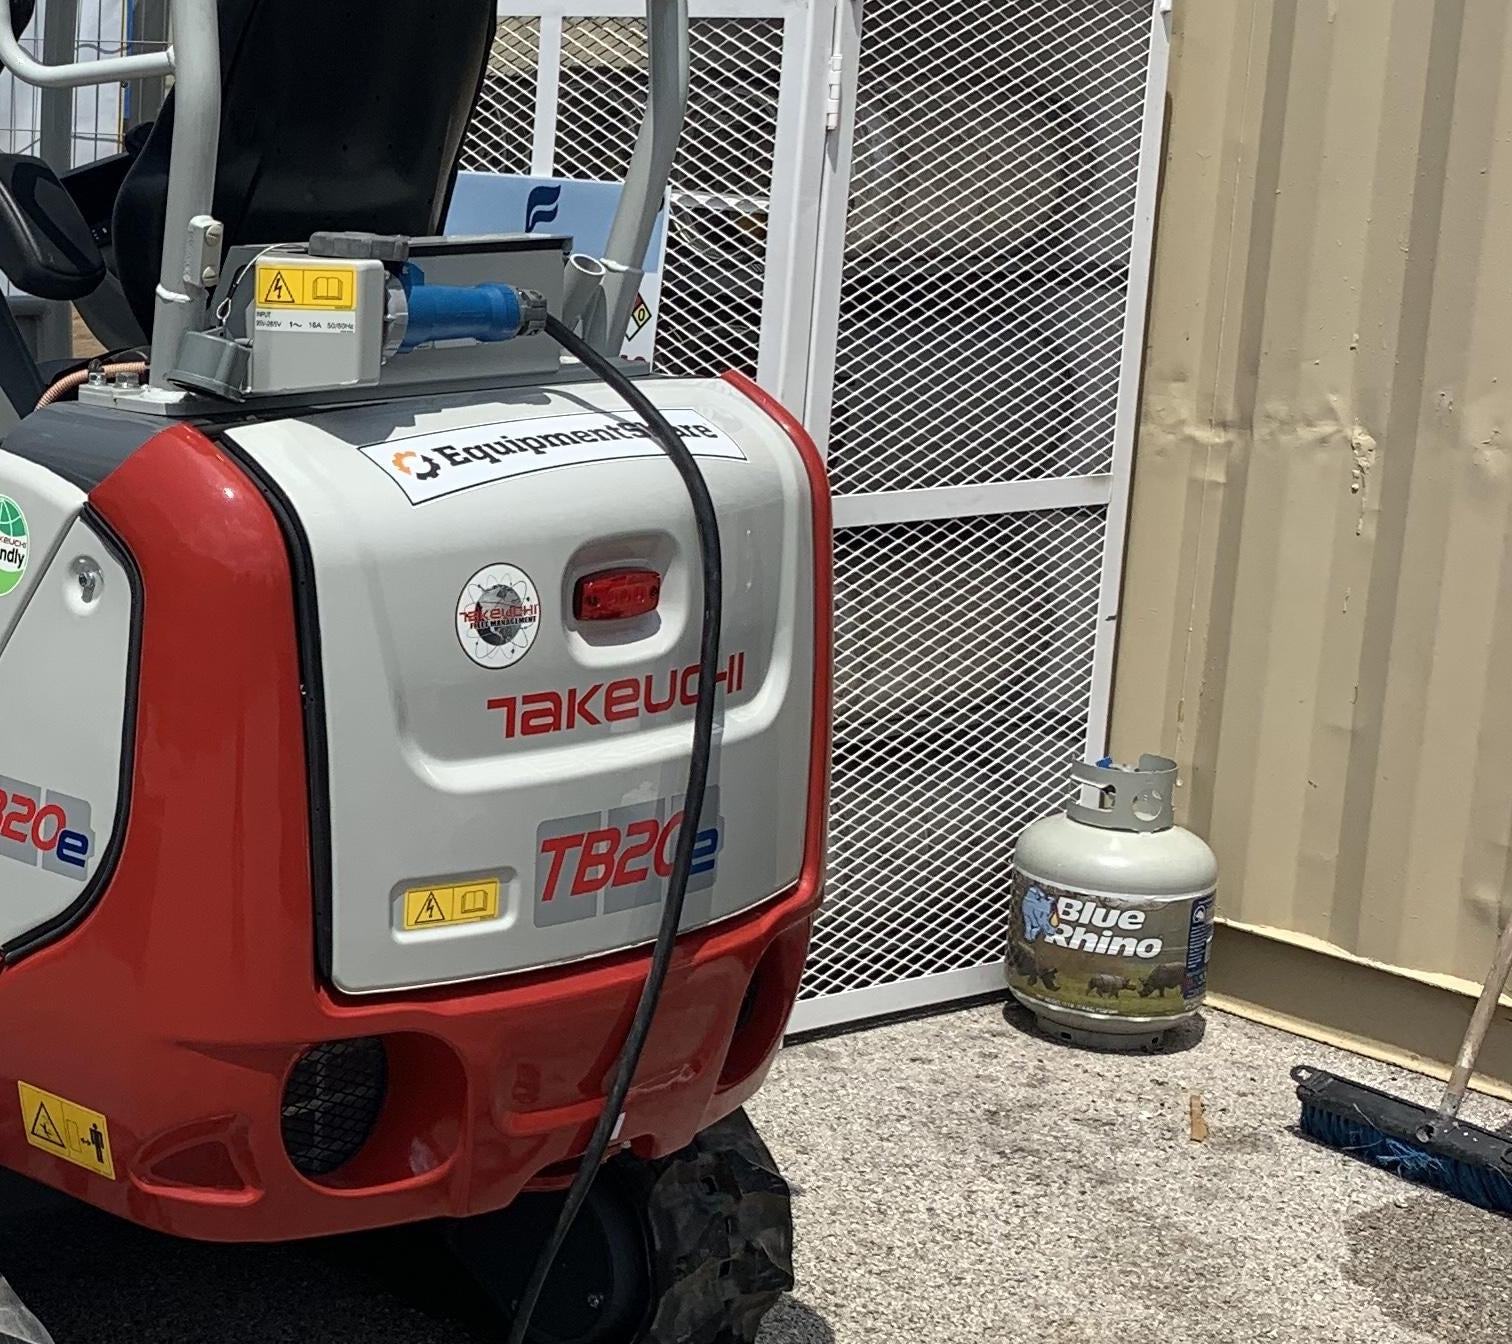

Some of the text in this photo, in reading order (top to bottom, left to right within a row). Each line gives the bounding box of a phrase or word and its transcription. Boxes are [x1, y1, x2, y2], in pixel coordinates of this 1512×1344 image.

[431, 421, 719, 466] EquipmentSare
[1055, 896, 1146, 930] Blue
[1044, 923, 1164, 958] Rhino
